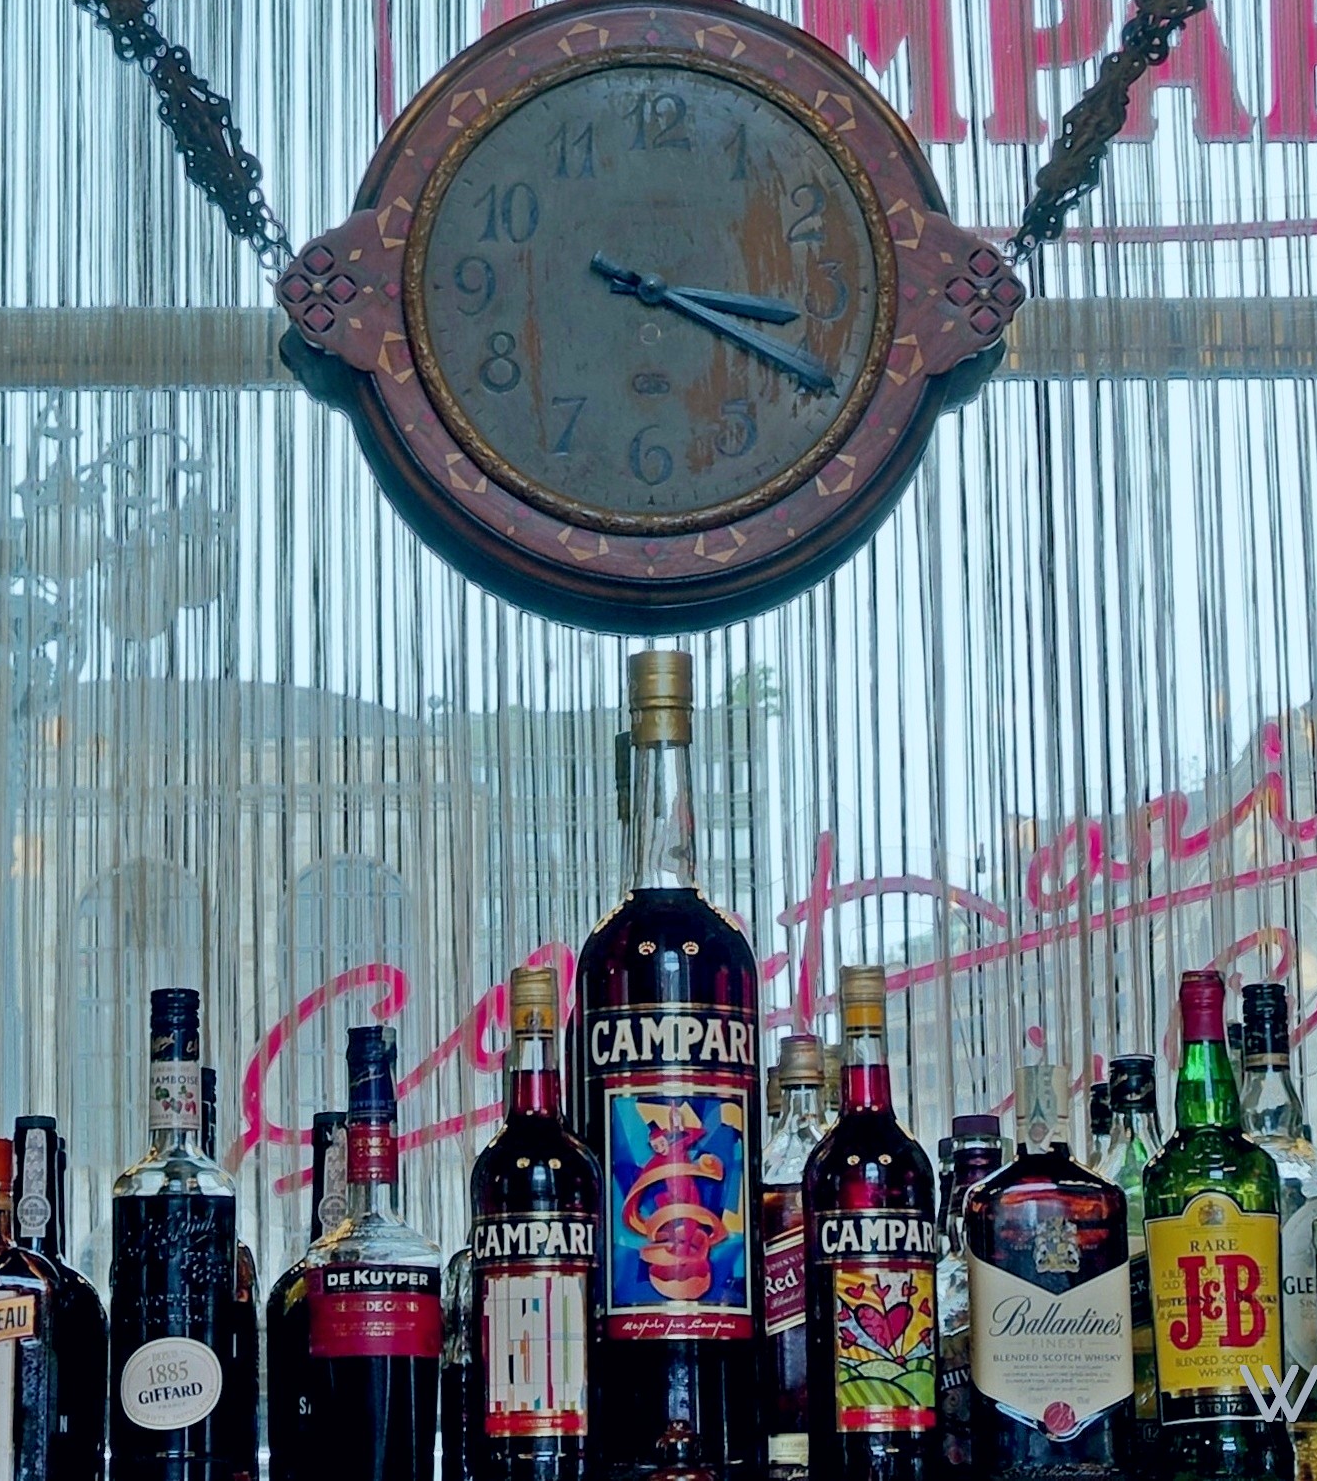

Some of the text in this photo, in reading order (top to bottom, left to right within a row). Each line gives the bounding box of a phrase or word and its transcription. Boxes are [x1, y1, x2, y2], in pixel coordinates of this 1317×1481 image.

[623, 93, 692, 151] 12
[546, 122, 597, 179] 11
[726, 123, 747, 181] 1
[475, 182, 539, 244] 10
[788, 184, 825, 244] 2
[454, 256, 496, 315] 9
[806, 260, 850, 320] 3
[480, 331, 521, 393] 8
[552, 397, 587, 455] 7
[715, 398, 758, 457] 5
[630, 425, 673, 486] 6
[592, 1017, 754, 1065] CAMPARI
[474, 1223, 594, 1260] CAMPARI
[1190, 1239, 1238, 1252] RARE
[327, 1269, 429, 1286] DE KUYPER
[765, 1268, 799, 1297] Red
[989, 1295, 1124, 1336] Ballantine's
[993, 1353, 1122, 1362] BLENDED SCOTCH WHISKY
[1031, 1339, 1085, 1349] FINEST
[1176, 1353, 1264, 1367] BLENDED SCOTCH
[138, 1382, 203, 1405] GIFFARD
[147, 1360, 189, 1386] 1885
